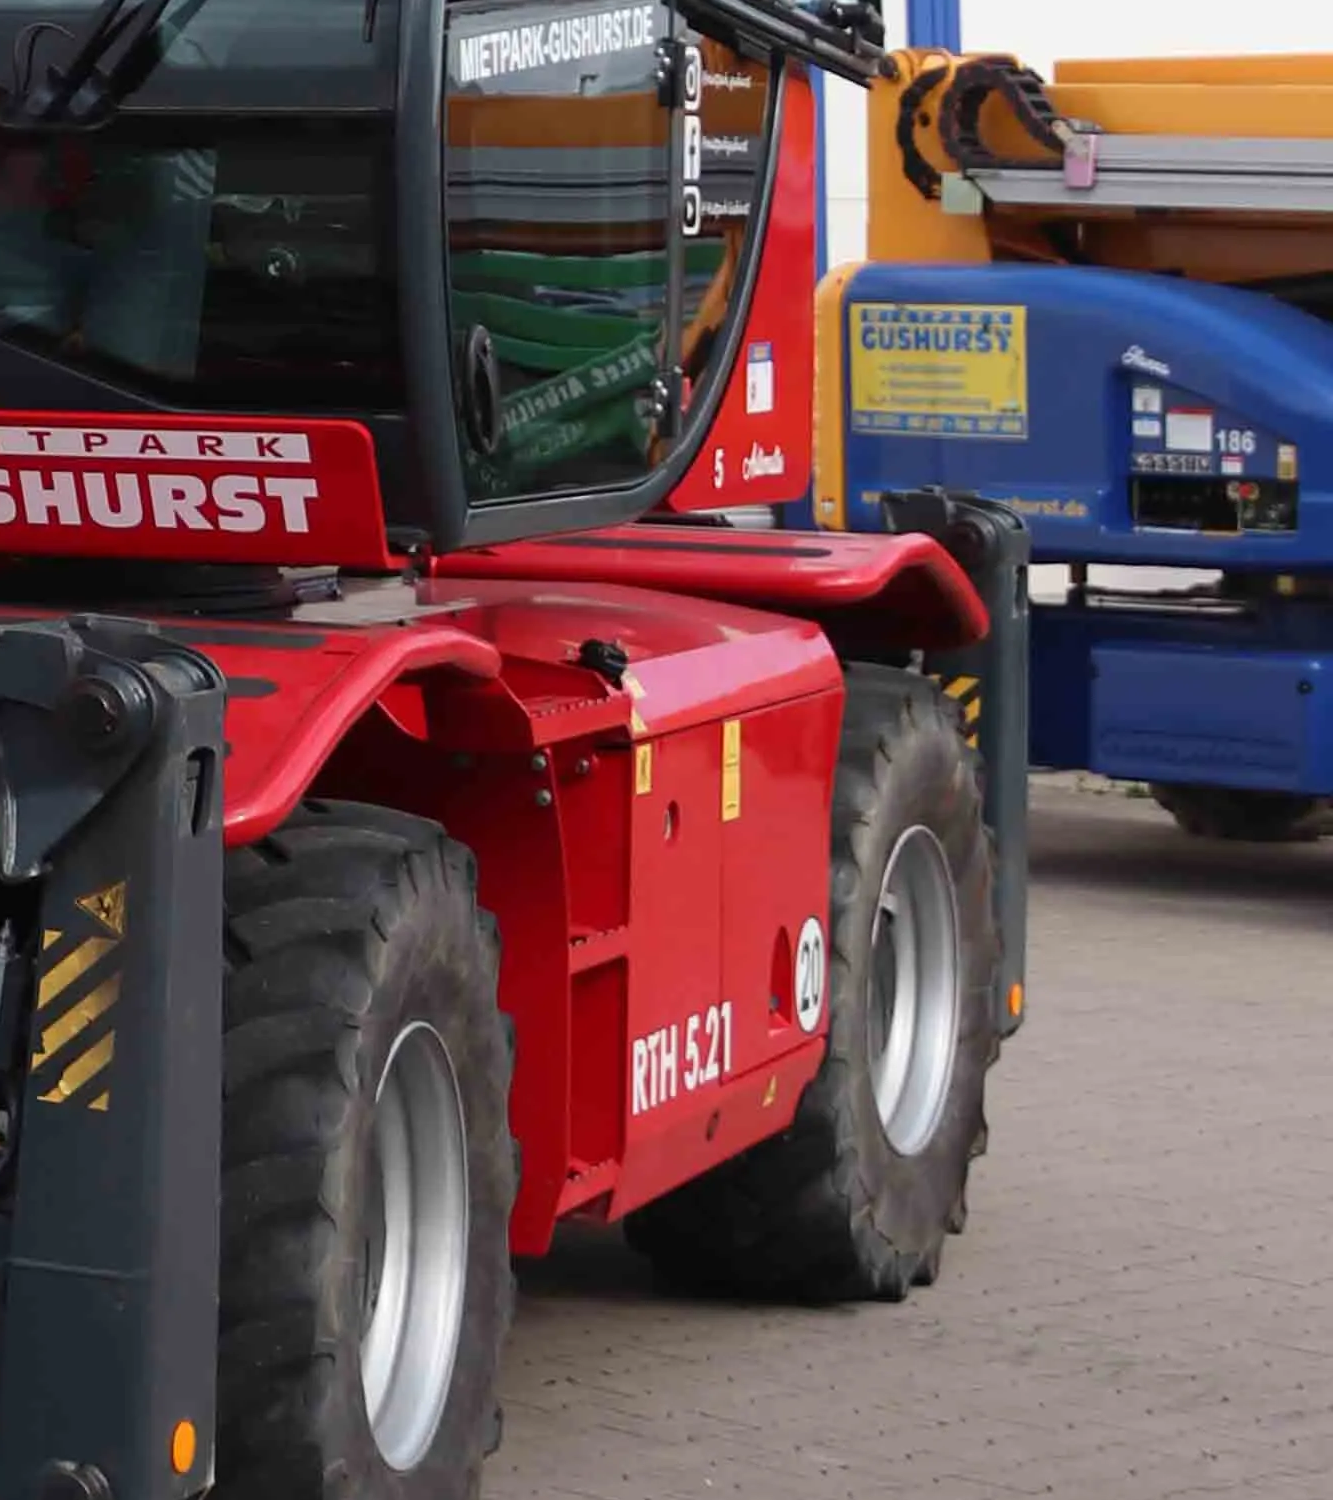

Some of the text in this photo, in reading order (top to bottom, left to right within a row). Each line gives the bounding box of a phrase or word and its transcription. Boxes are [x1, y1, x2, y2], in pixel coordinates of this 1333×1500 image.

[459, 5, 653, 82] MIETPARK-GUSHURST.DE
[861, 326, 1011, 352] GUSHURST
[714, 448, 724, 489] 5
[1215, 429, 1256, 454] 186
[800, 936, 821, 1012] 20
[633, 1001, 732, 1116] RTH 5.21
